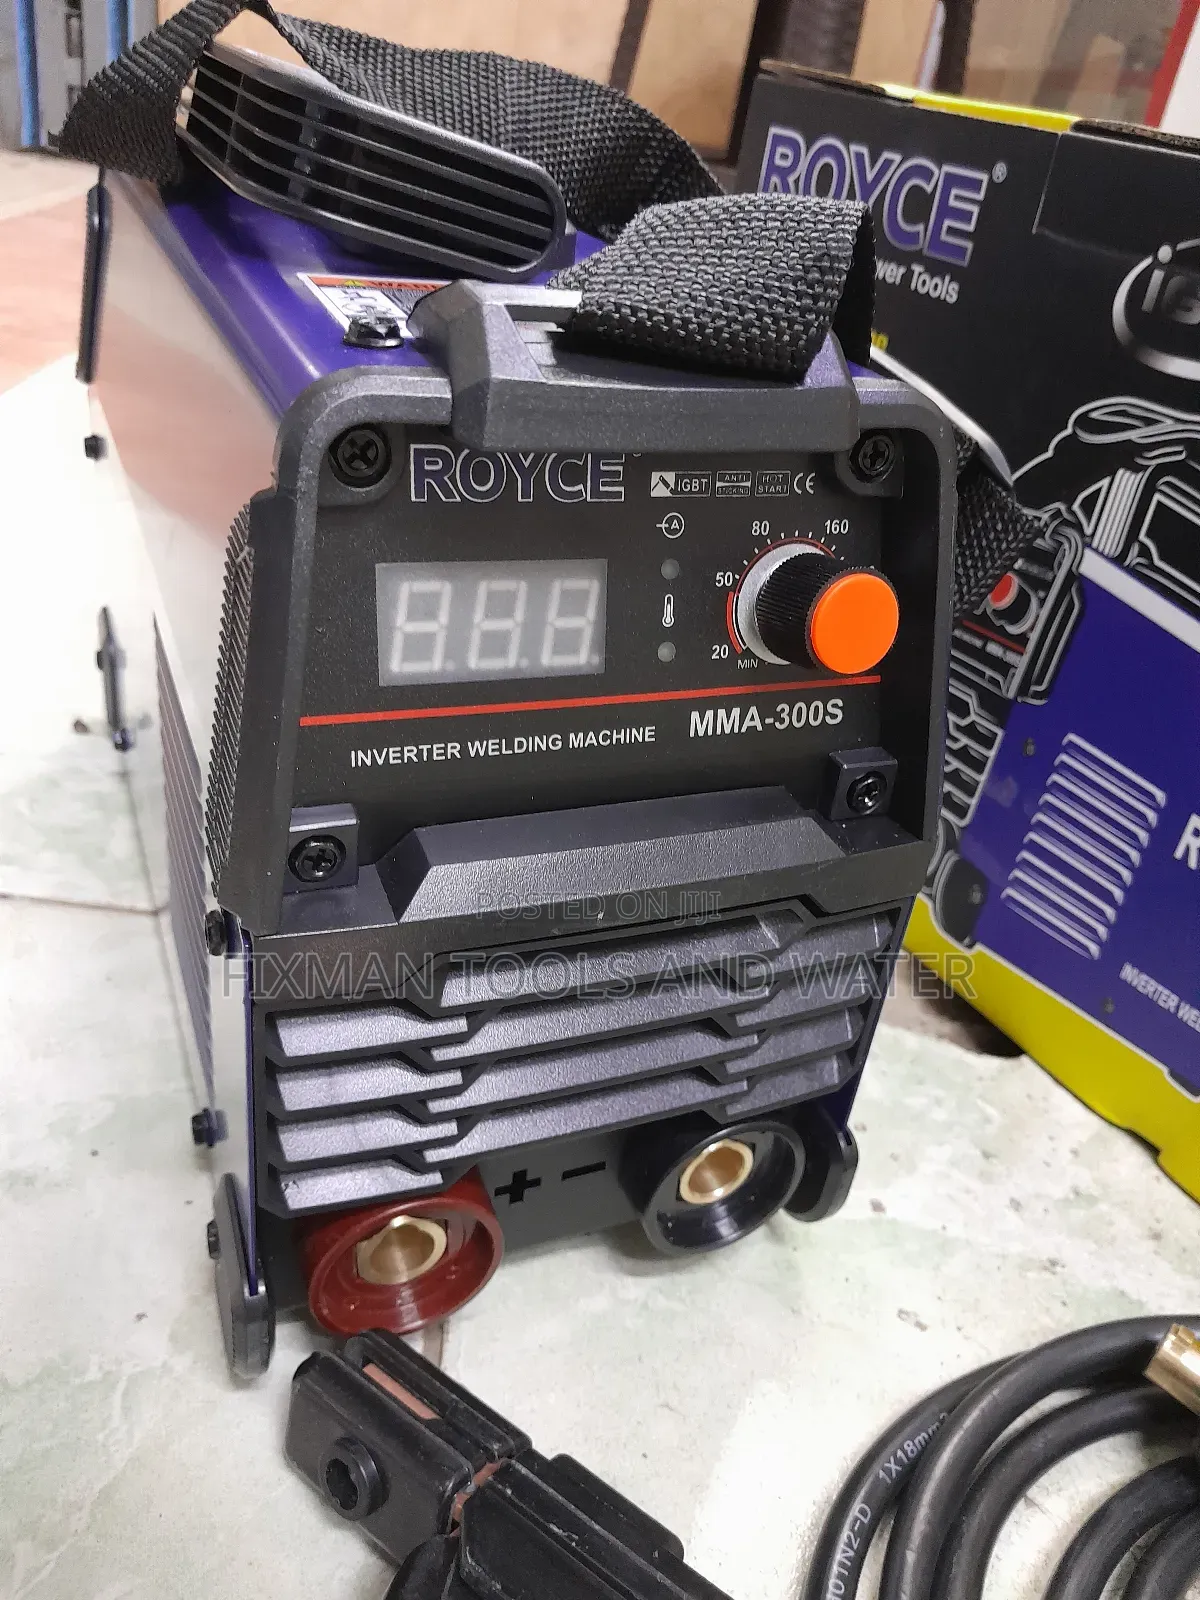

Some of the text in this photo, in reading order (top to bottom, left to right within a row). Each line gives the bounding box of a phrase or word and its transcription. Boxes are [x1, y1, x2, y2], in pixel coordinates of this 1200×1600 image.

[910, 263, 960, 304] Tools
[409, 443, 625, 503] ROYCE
[762, 474, 783, 483] HOT
[678, 478, 708, 492] IGBT
[758, 485, 787, 494] START
[751, 520, 770, 536] 80
[824, 519, 849, 535] 160
[715, 571, 733, 587] 50
[711, 644, 729, 660] 20
[737, 658, 759, 670] MIN
[689, 698, 844, 738] MMA-300S
[350, 725, 656, 768] INVERTER WELDING MACHINE
[1119, 961, 1181, 1015] INVERTER
